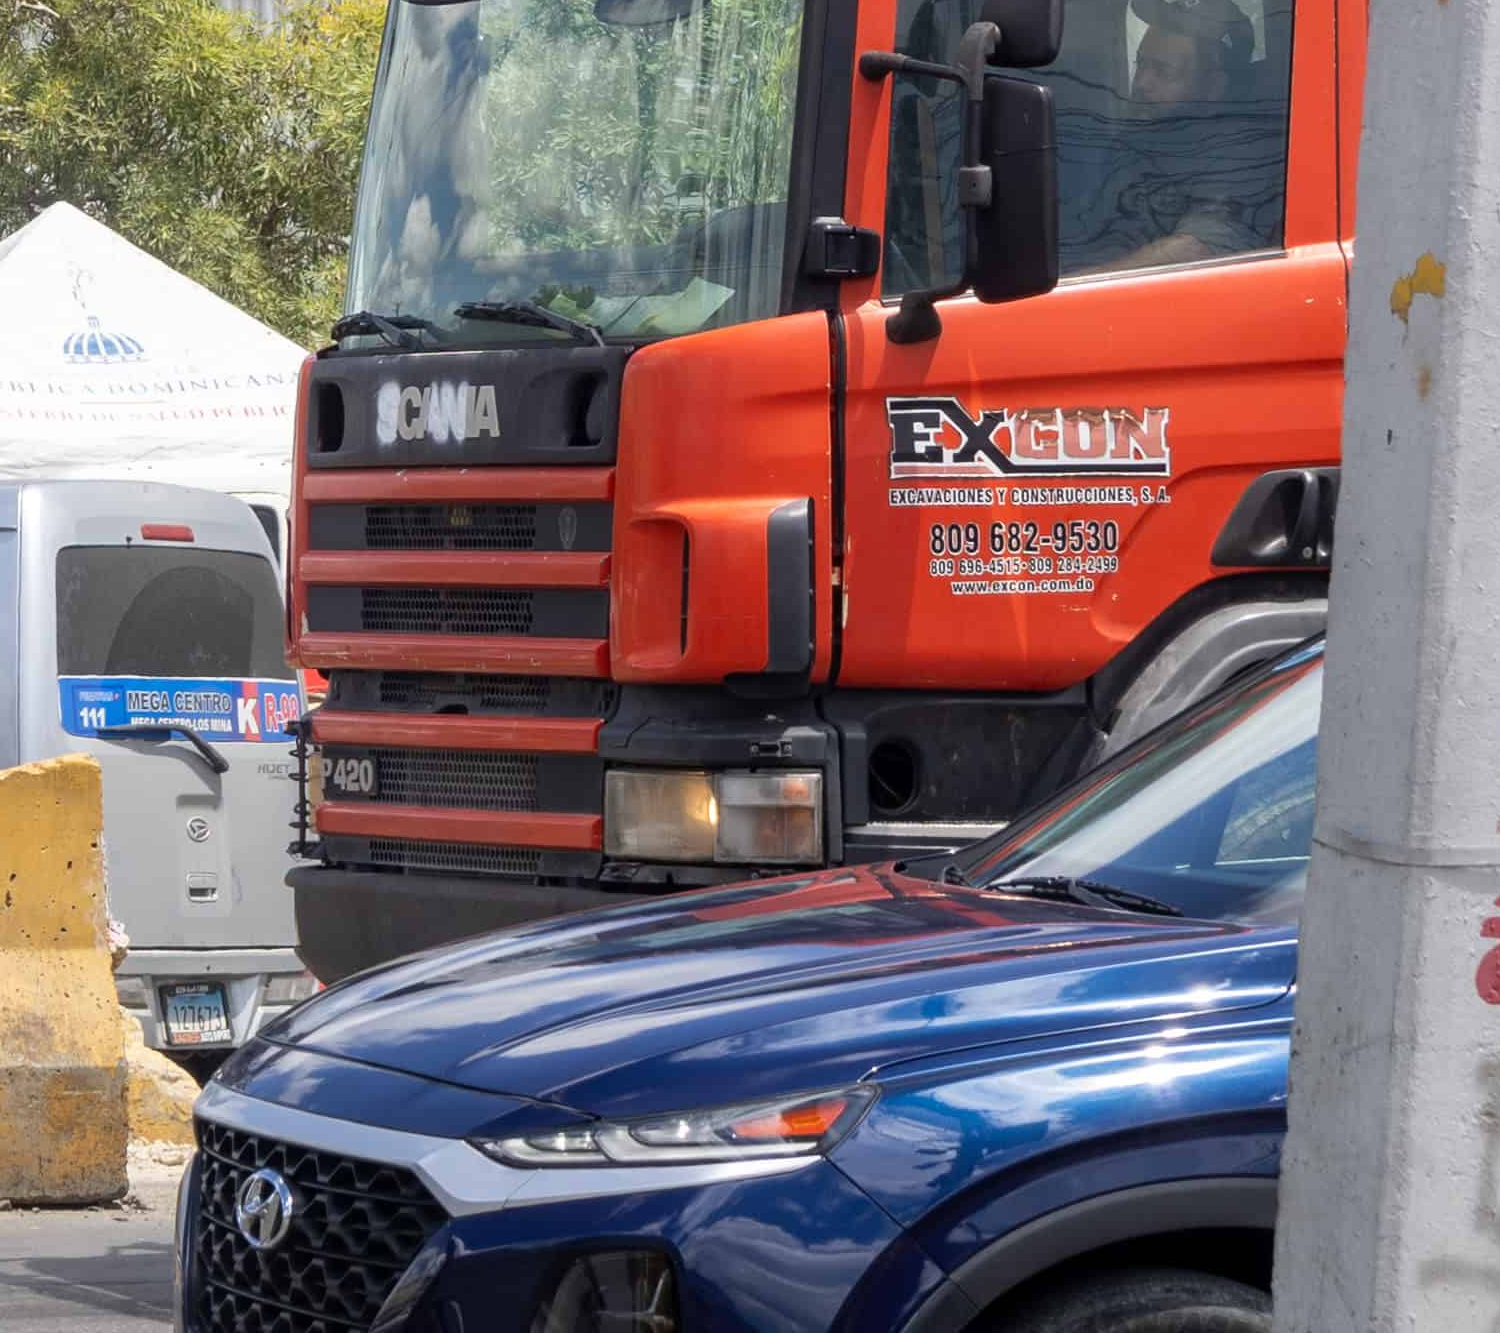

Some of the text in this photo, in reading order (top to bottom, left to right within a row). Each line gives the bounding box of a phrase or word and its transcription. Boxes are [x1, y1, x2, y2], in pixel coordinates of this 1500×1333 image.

[376, 382, 500, 444] SCANIA
[887, 398, 1169, 476] EXCON
[889, 485, 1170, 506] EXCAVACIONES Y CONSTRUCCIONES, S. A.
[930, 520, 1118, 555] 809 682-9530
[930, 559, 953, 576] 809
[1057, 556, 1117, 574] 284-2499
[952, 577, 1093, 595] www.excon.com.do
[127, 690, 171, 712] MEGA
[174, 690, 232, 713] CENTRO
[79, 707, 106, 728] 111
[237, 697, 259, 735] K
[257, 764, 292, 775] HIJET
